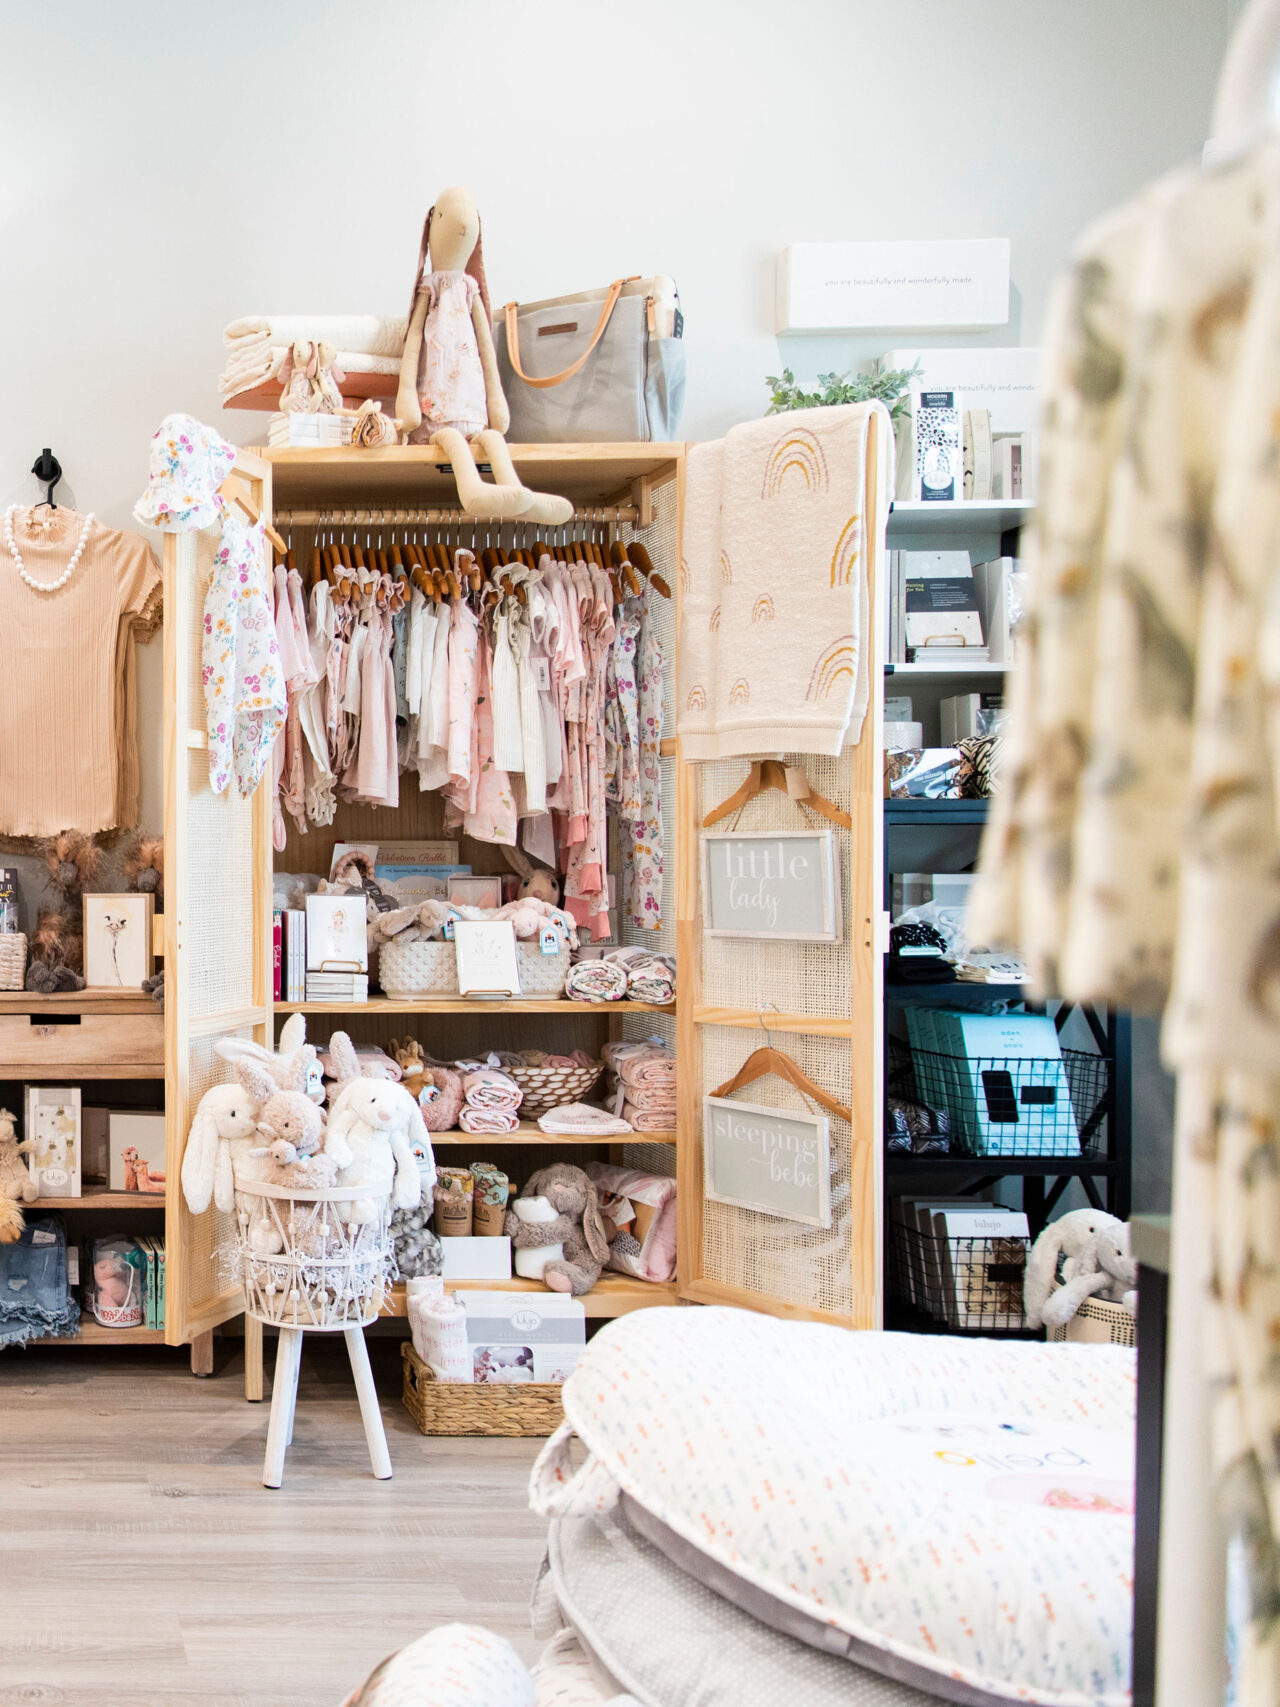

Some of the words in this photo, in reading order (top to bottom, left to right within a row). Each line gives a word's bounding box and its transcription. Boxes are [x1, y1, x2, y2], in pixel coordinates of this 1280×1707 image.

[853, 277, 892, 286] beautifully
[893, 277, 907, 285] and
[907, 277, 950, 286] wonderfully
[958, 384, 996, 392] beautifully
[724, 842, 809, 880] little
[729, 876, 780, 928] lady
[715, 1113, 818, 1164] sleeping
[754, 1148, 819, 1188] bebe
[441, 1319, 463, 1330] little
[434, 1337, 463, 1348] sister
[441, 1357, 466, 1367] little
